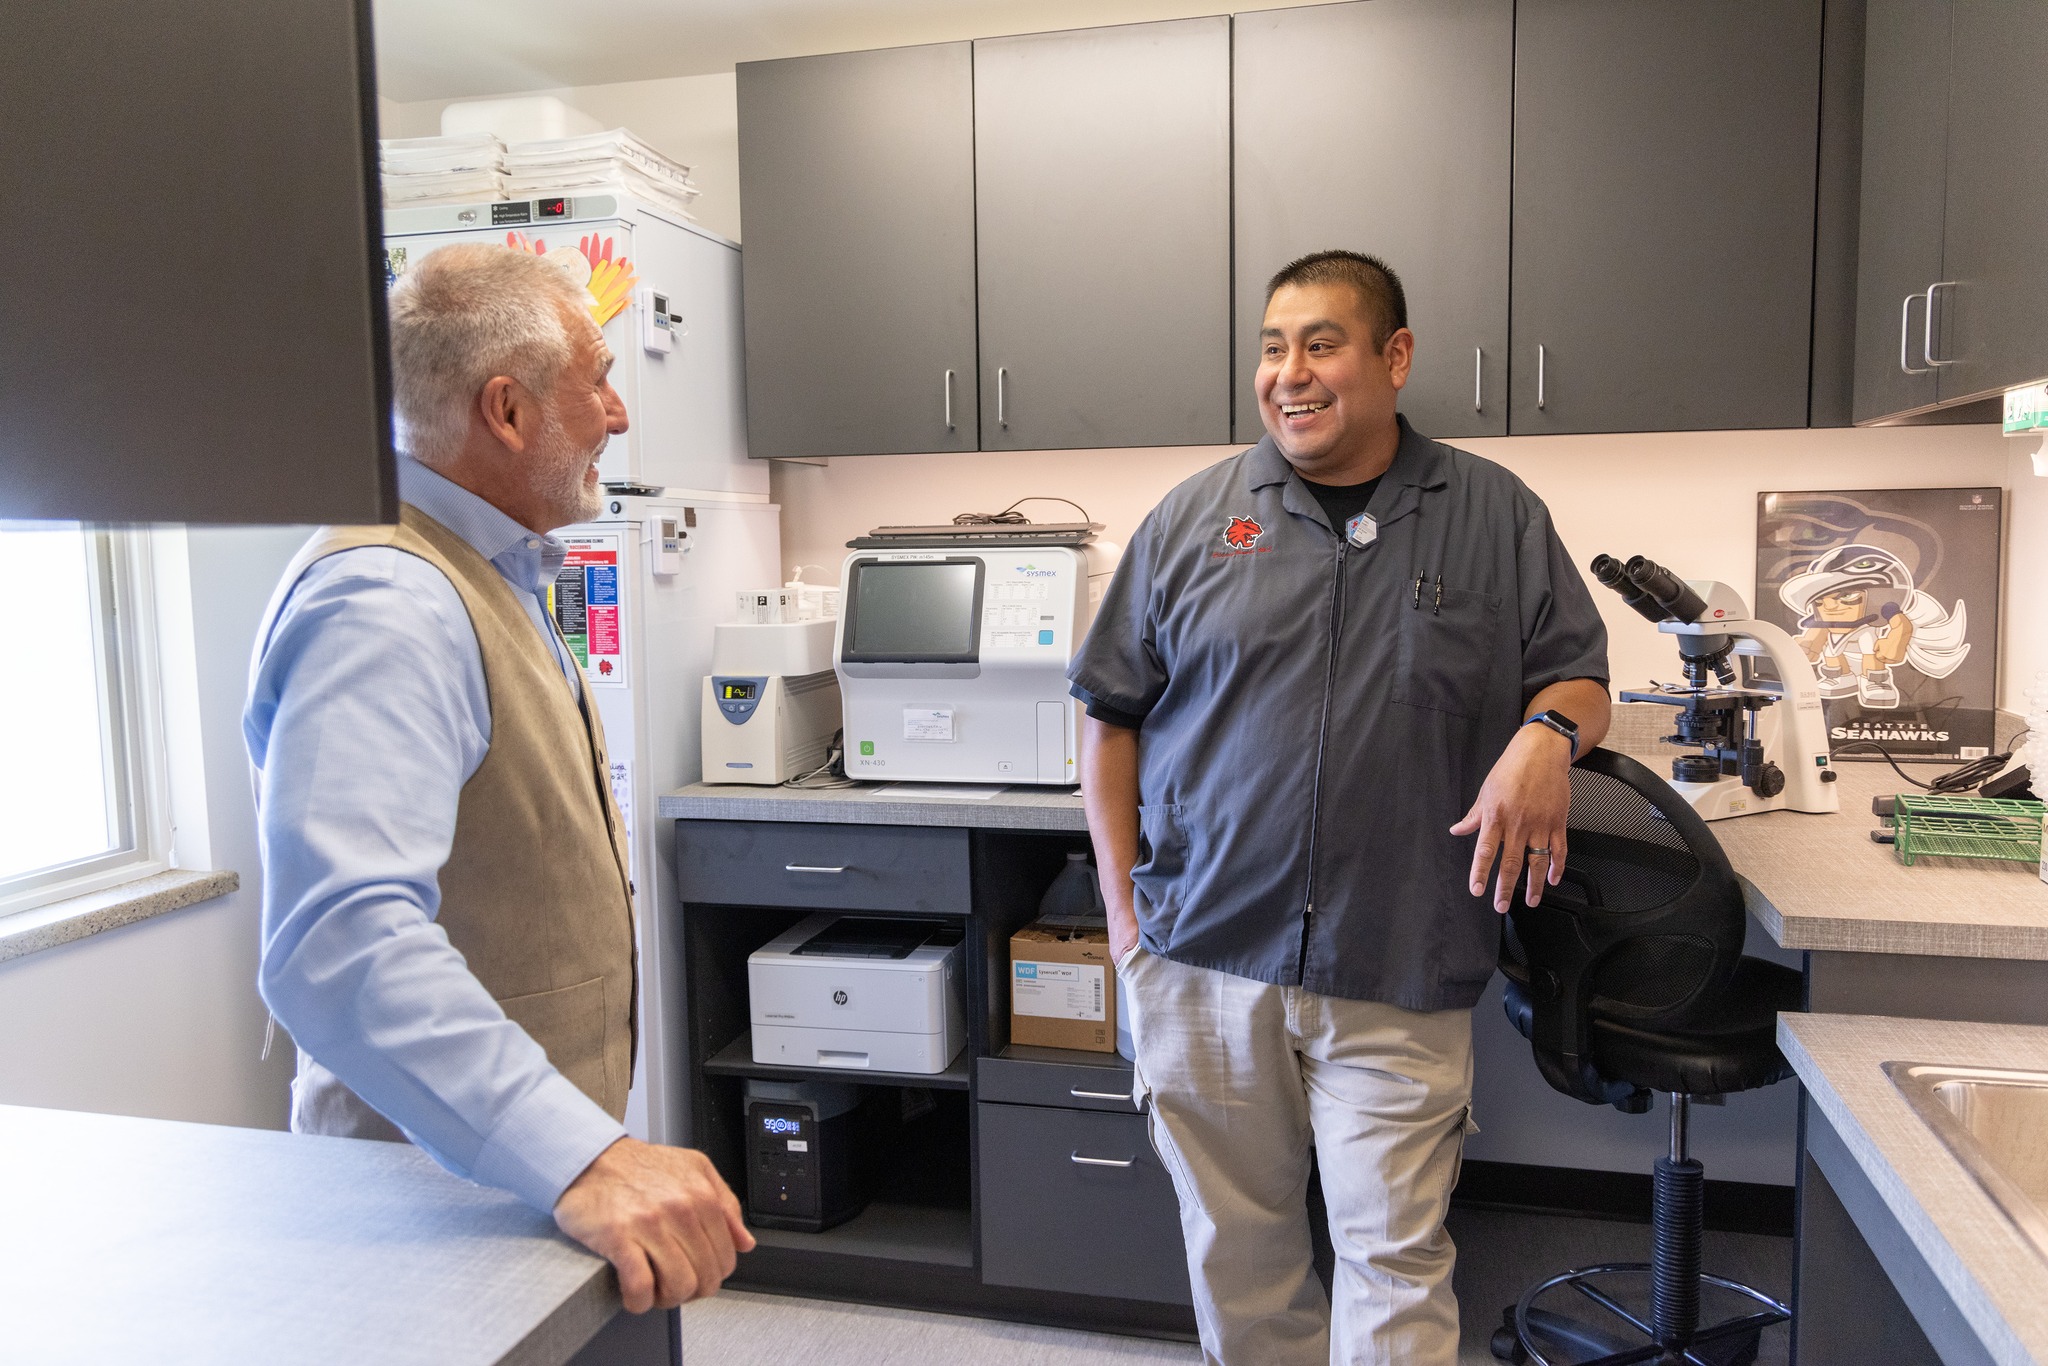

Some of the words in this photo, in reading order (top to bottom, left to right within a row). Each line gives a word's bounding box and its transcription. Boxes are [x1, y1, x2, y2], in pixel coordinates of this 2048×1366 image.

[1831, 727, 1950, 741] SEAHAWKS
[1018, 967, 1036, 975] WDF
[834, 991, 847, 1005] hp
